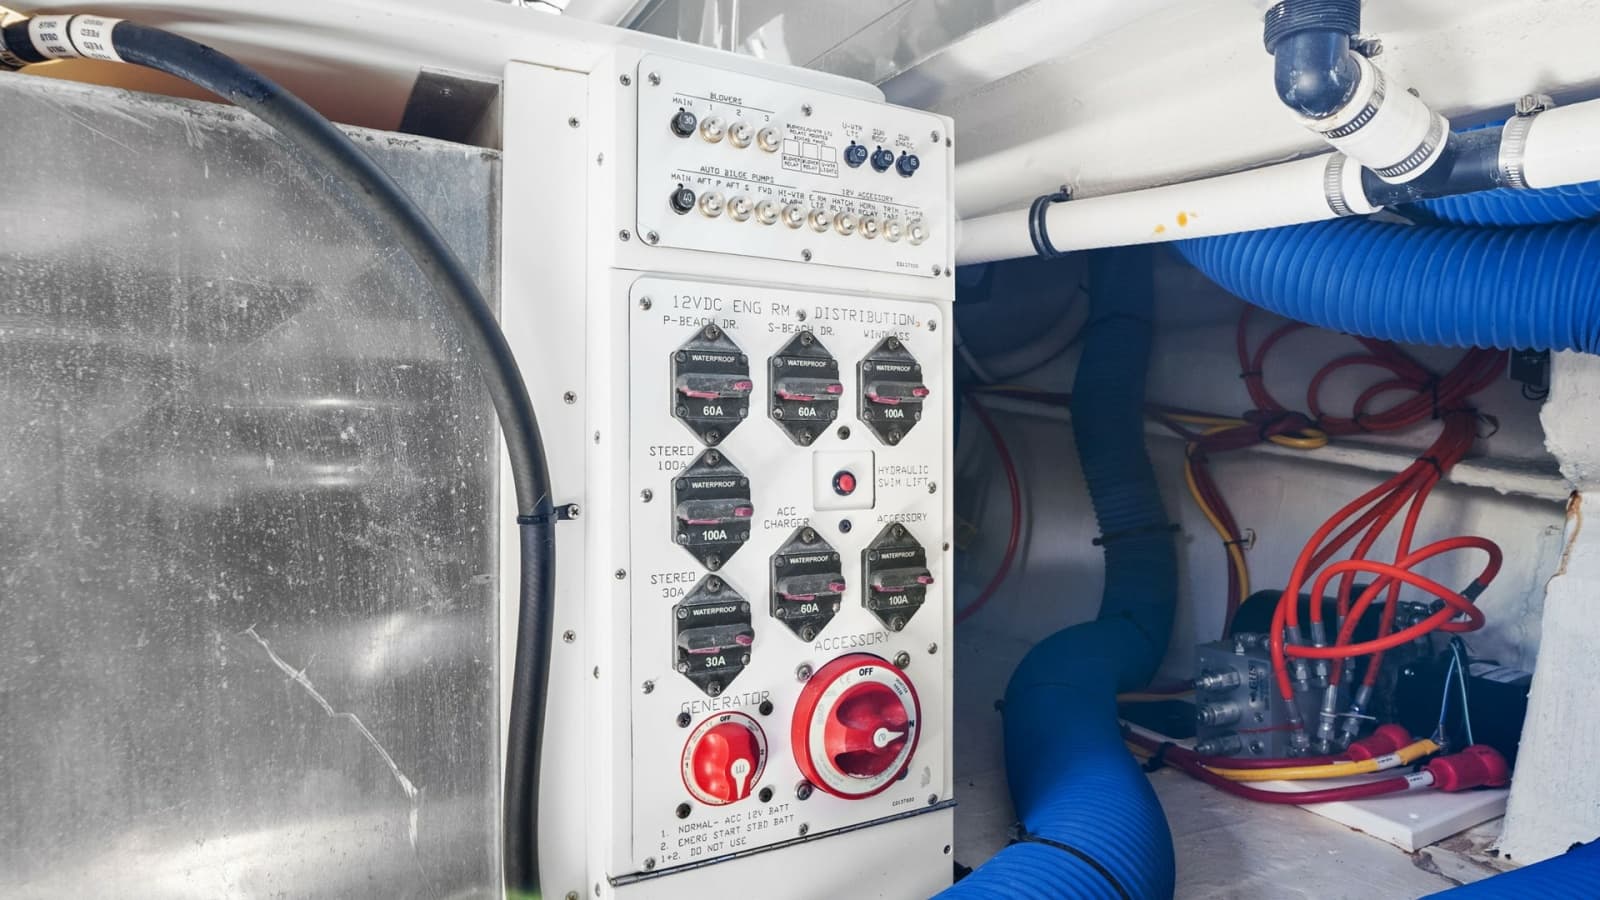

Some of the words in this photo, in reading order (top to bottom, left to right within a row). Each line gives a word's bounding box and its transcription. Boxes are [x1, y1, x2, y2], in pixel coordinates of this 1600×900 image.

[673, 97, 693, 106] MAIN
[710, 92, 743, 104] BLOWERS
[684, 115, 694, 125] 30
[842, 121, 862, 132] U-WTR
[671, 174, 692, 182] MAIN
[700, 166, 720, 174] AUTO
[724, 169, 748, 180] BILGE
[752, 174, 774, 184] PUMPS
[697, 177, 712, 185] AFT
[758, 186, 773, 195] FWD
[778, 189, 804, 200] HI-WTR
[842, 188, 854, 197] 12V
[858, 192, 894, 202] ACCESSORY
[682, 193, 692, 202] 40
[832, 198, 854, 206] HATCH
[811, 200, 824, 208] LTS
[830, 204, 842, 213] RLY
[860, 202, 876, 210] HORN
[858, 209, 878, 217] RELAY
[673, 295, 722, 312] 12VDC
[733, 300, 762, 314] ENG
[772, 302, 790, 316] RM
[815, 306, 915, 326] DISTRIBUTION
[722, 319, 740, 329] DR.
[820, 326, 835, 336] DR.
[692, 354, 736, 363] WATERPROOF
[787, 359, 827, 368] WATERPROOF
[703, 406, 724, 416] 60A
[798, 407, 817, 417] 60A
[884, 408, 904, 418] 100A
[649, 446, 694, 456] STEREO
[658, 460, 688, 471] 100A
[878, 464, 928, 475] HYDRAULIC
[692, 480, 736, 489] WATERPROOF
[878, 478, 901, 488] SWIM
[906, 477, 929, 488] LIFT
[776, 506, 796, 516] ACC
[877, 512, 928, 523] ACCESSORY
[764, 518, 810, 530] CHARGER
[702, 530, 728, 540] 100A
[790, 555, 829, 564] WATERPROOF
[881, 551, 916, 560] WATERPROOF
[650, 572, 696, 584] STEREO
[662, 588, 684, 598] 30A
[889, 594, 909, 605] 100A
[692, 606, 737, 616] WATERPROOF
[800, 604, 819, 614] 60A
[814, 631, 890, 652] ACCESSORY
[706, 656, 726, 668] 30A
[858, 668, 874, 676] OFF
[680, 690, 770, 714] GENERATOR
[662, 830, 669, 838] 1.
[678, 820, 719, 834] NORMAL-
[724, 814, 742, 824] ACC
[748, 810, 763, 820] 12V
[769, 804, 789, 816] BATT
[660, 842, 669, 851] 2.
[678, 834, 708, 847] EMERG
[714, 826, 740, 840] START
[746, 820, 768, 832] STBD
[774, 814, 794, 826] BATT
[662, 852, 680, 863] 1+2.
[690, 847, 702, 857] DO
[707, 842, 724, 853] NOT
[730, 836, 747, 848] USE
